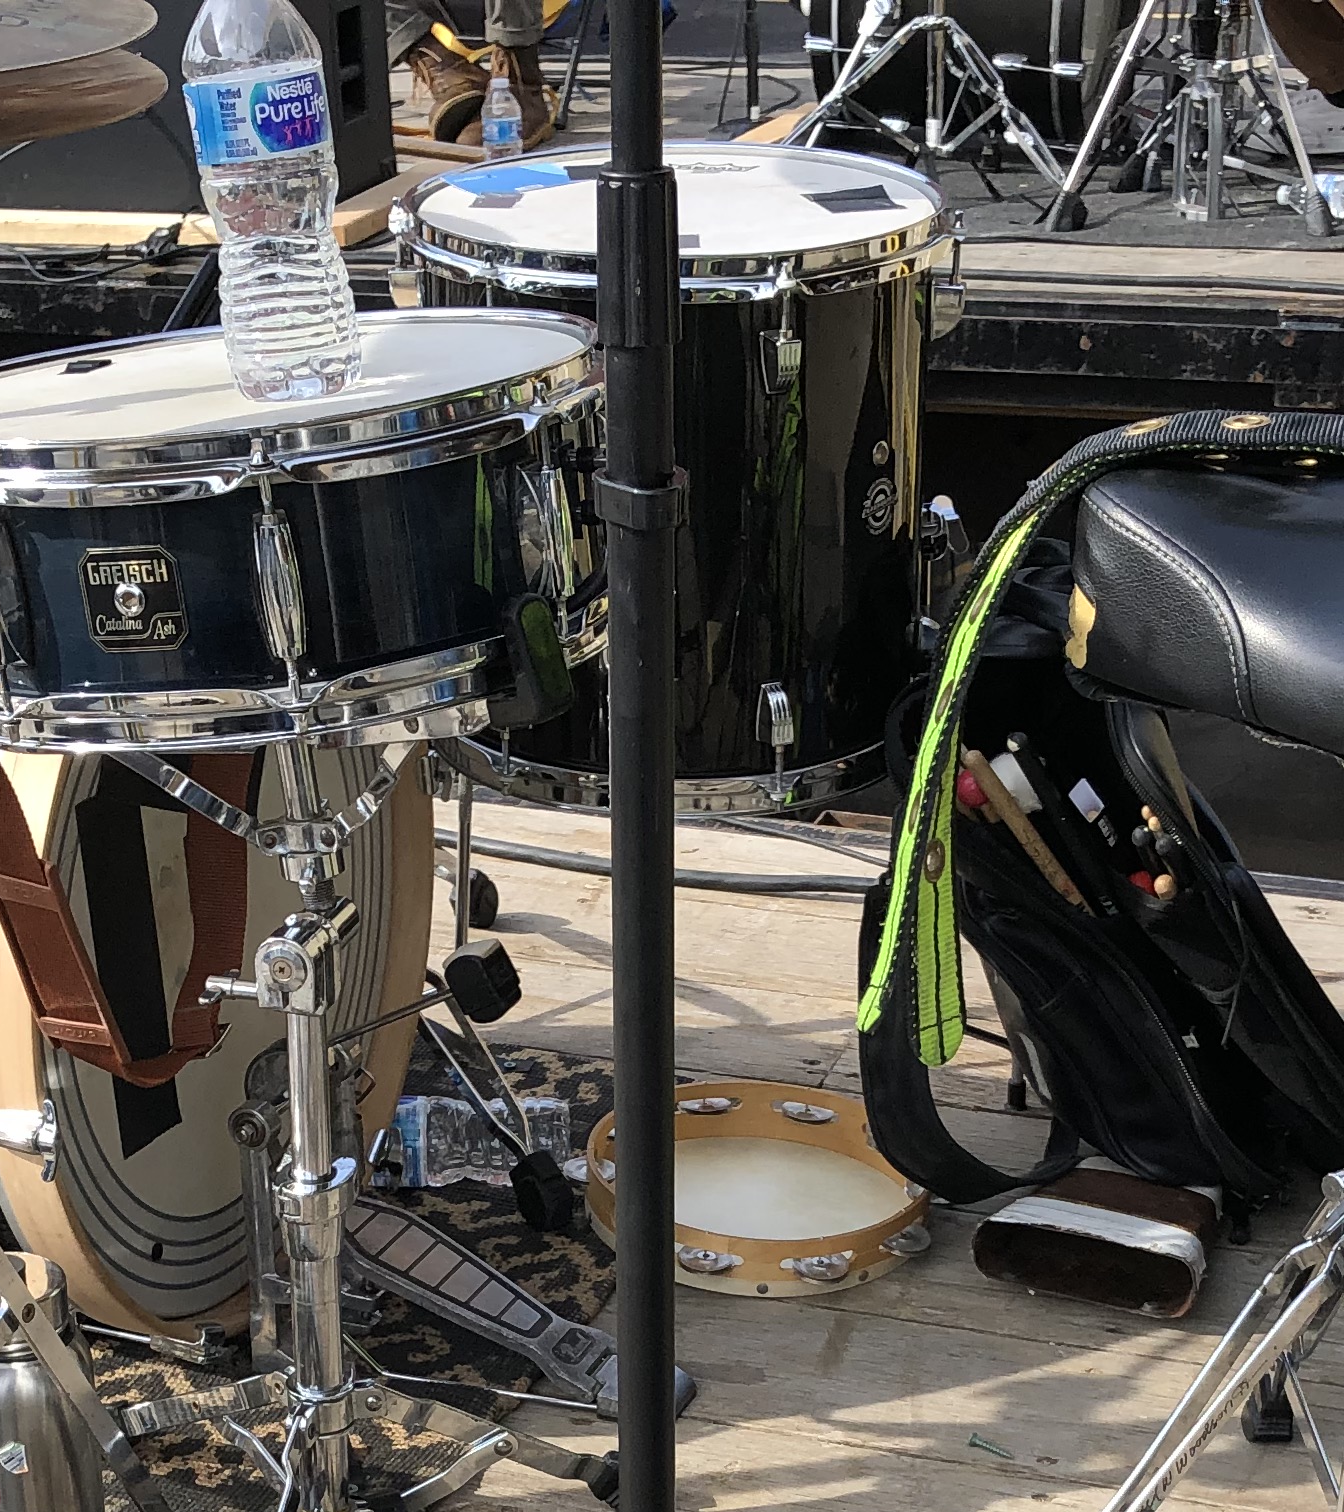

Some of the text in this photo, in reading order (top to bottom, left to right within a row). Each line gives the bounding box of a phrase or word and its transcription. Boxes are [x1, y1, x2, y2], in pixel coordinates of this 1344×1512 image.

[254, 101, 303, 125] Pure
[303, 92, 326, 123] Life
[86, 559, 169, 585] GRETSCH
[96, 614, 176, 640] Catalina Ash
